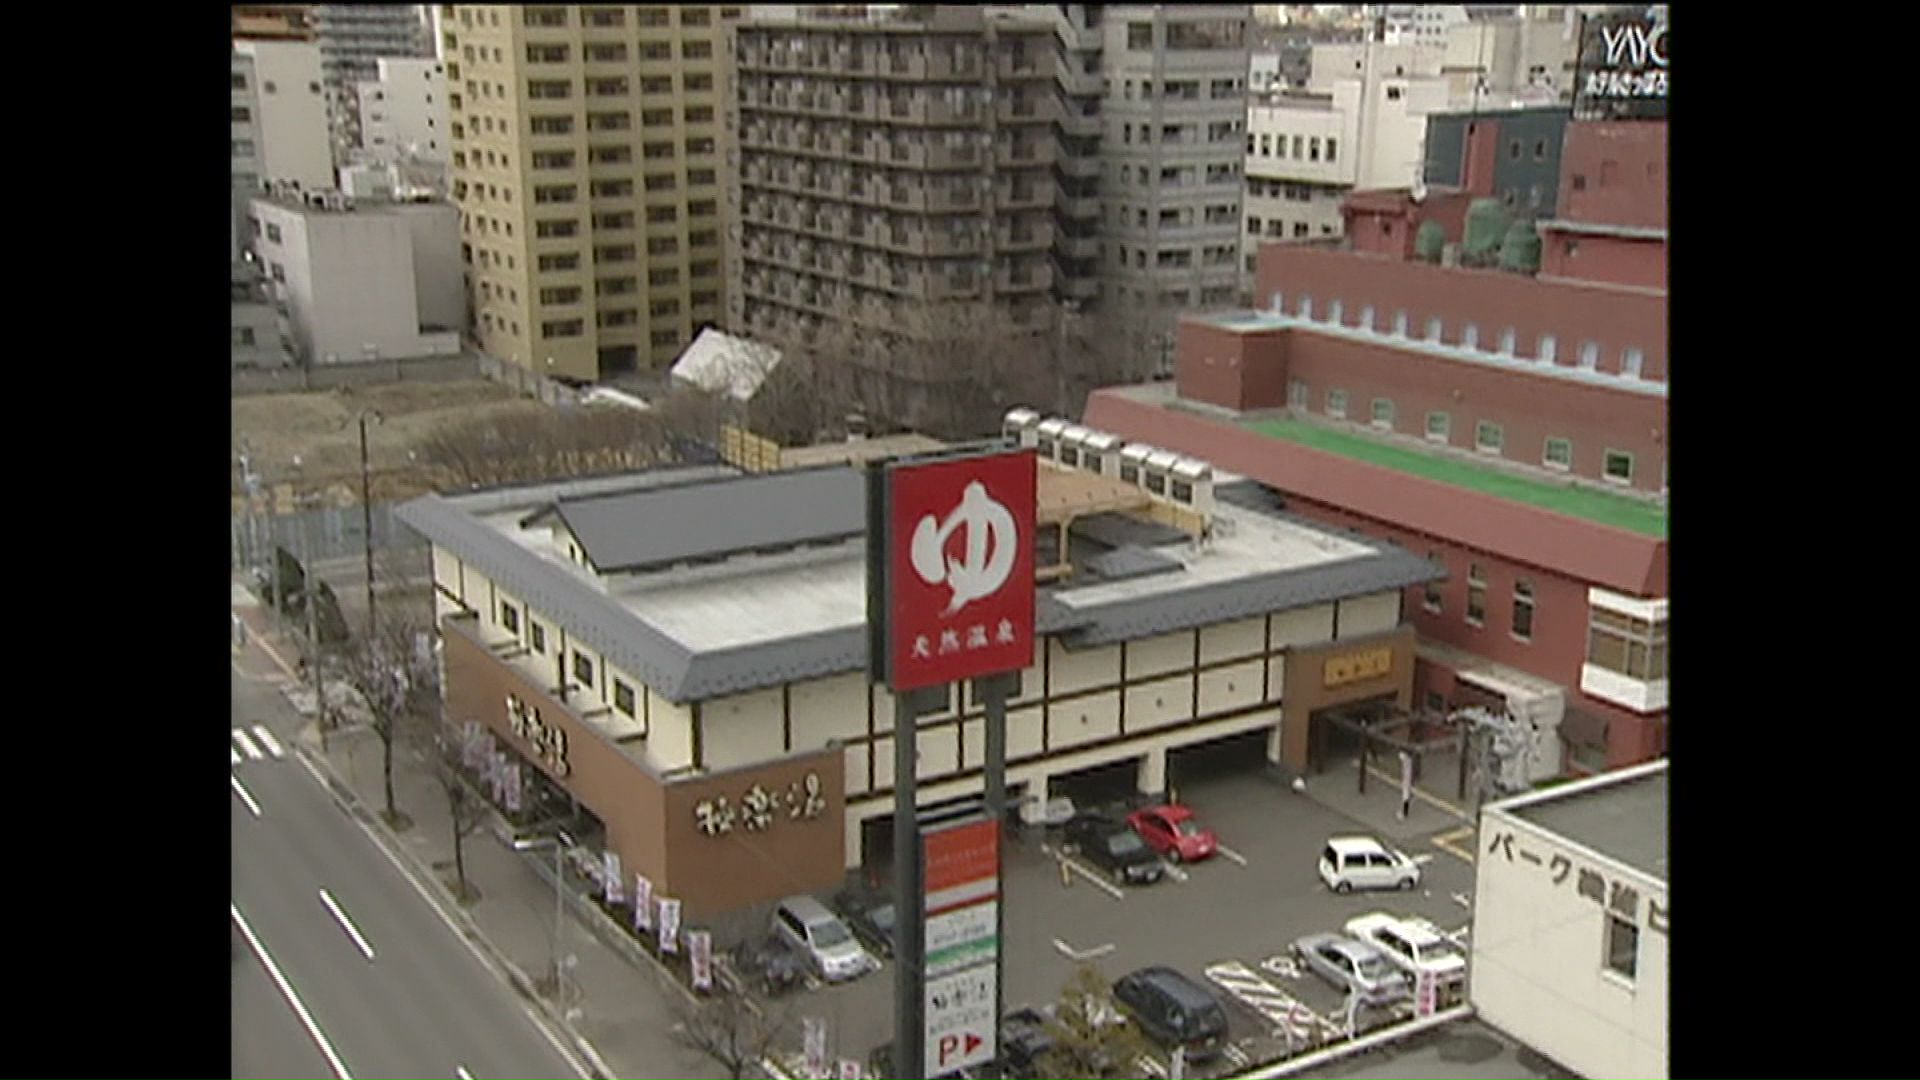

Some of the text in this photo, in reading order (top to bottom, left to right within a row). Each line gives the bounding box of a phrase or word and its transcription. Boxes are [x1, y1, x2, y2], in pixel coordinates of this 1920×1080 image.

[911, 479, 1018, 618] ゆ
[910, 618, 1015, 659] 天然温泉
[695, 771, 827, 837] 極楽湯
[938, 1034, 959, 1067] P
